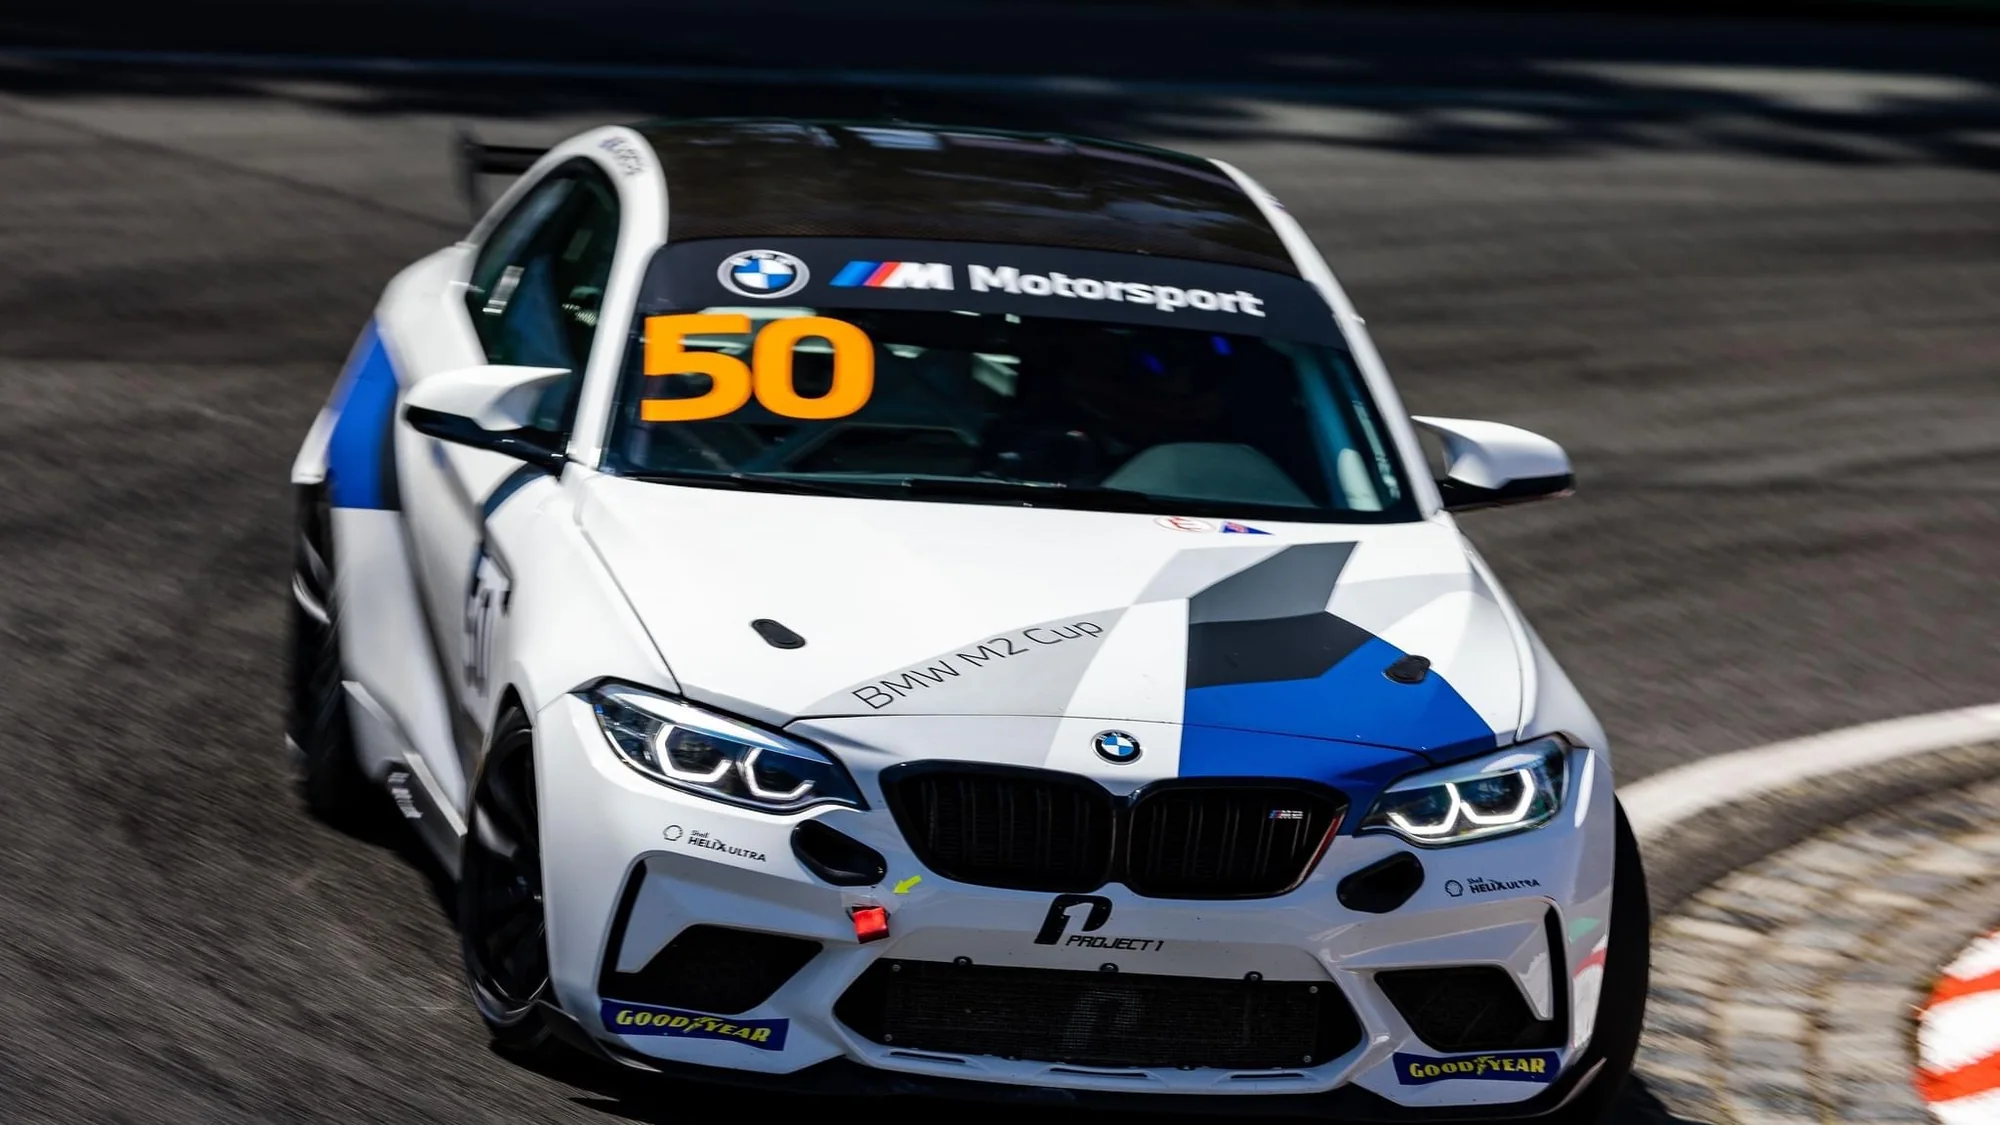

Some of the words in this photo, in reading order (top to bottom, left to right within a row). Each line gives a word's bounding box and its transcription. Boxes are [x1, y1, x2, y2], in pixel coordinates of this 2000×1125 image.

[968, 264, 1266, 317] Motorsport
[641, 313, 875, 422] 50
[852, 660, 960, 709] BMW
[956, 637, 1029, 667] M2
[1023, 621, 1104, 645] Cup
[688, 836, 726, 852] HELIX
[728, 846, 766, 862] ULTRA
[1469, 879, 1506, 893] HELIX
[1505, 879, 1541, 890] ULTRA
[1065, 935, 1153, 951] PROJECT
[1154, 940, 1165, 951] 1
[616, 1010, 772, 1042] GOODYEAR
[1409, 1056, 1546, 1078] GOODYEAR
